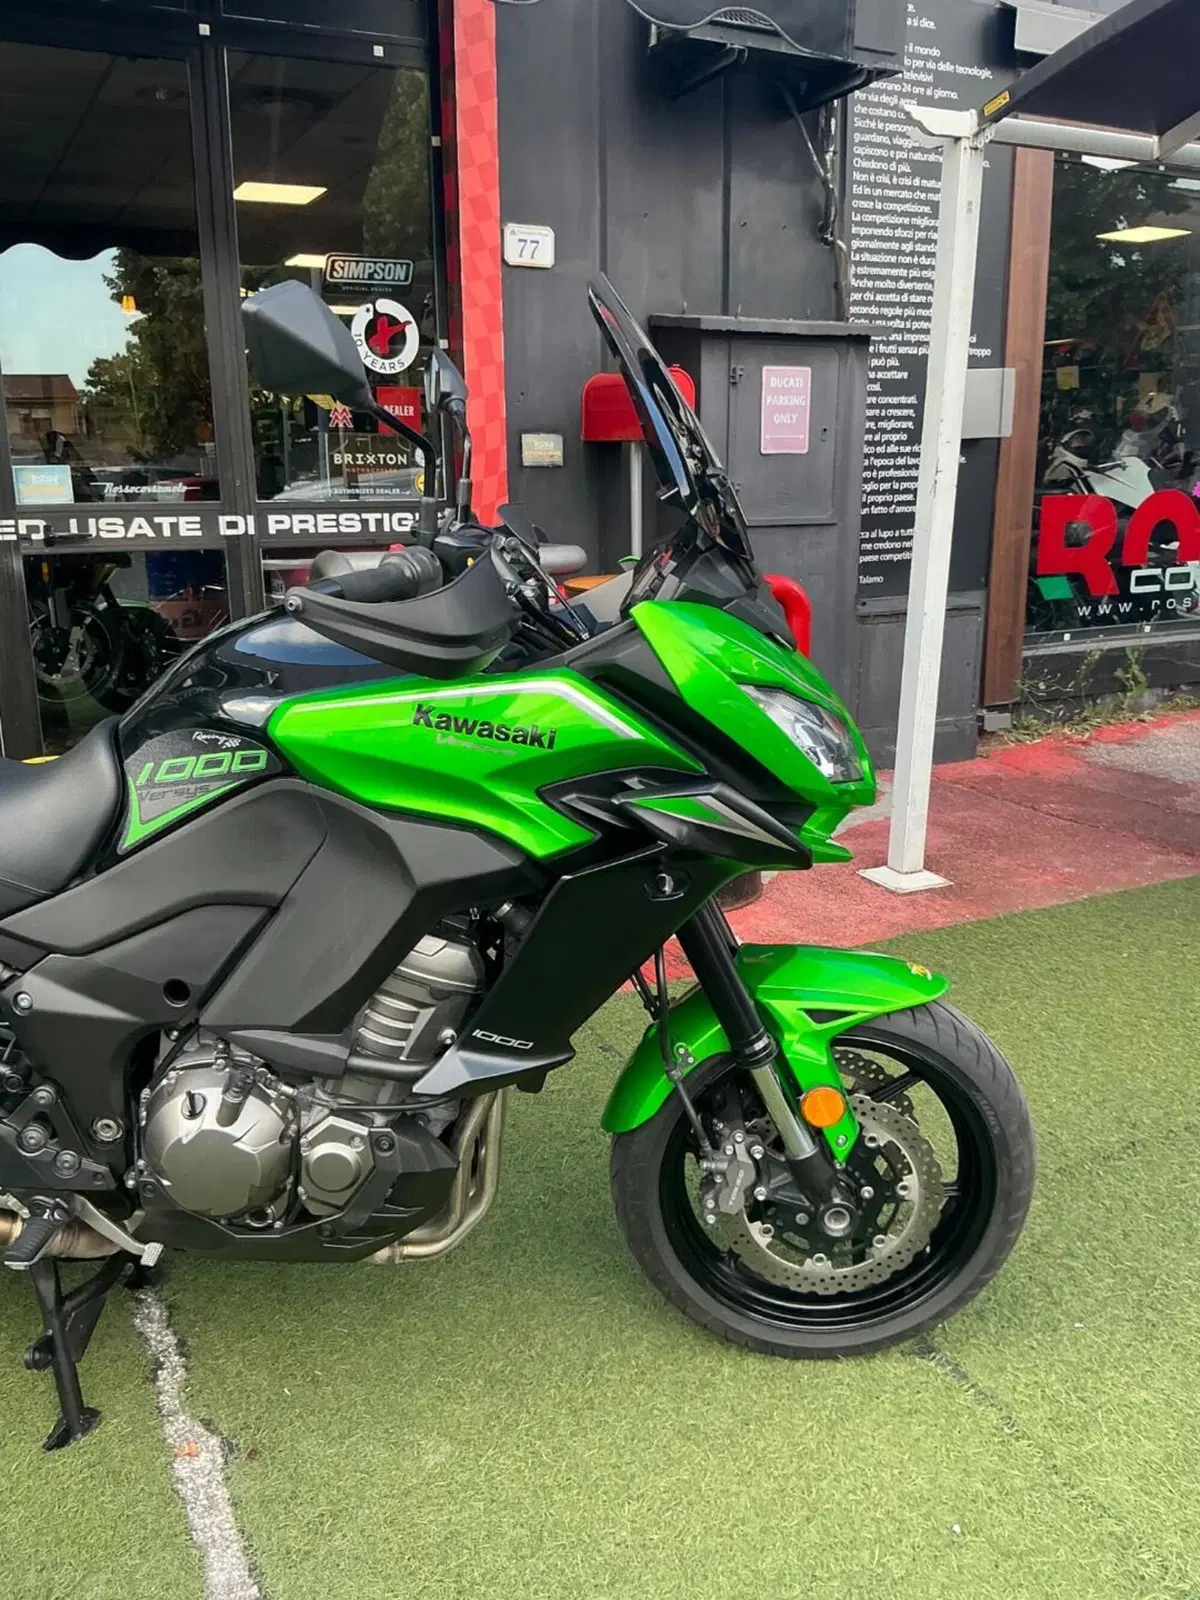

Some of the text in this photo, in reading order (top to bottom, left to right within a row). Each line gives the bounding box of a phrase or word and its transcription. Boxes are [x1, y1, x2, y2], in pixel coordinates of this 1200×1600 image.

[914, 45, 941, 57] mondo
[912, 60, 925, 69] per
[926, 60, 936, 70] via
[937, 61, 955, 72] delle
[902, 83, 911, 93] 24
[912, 87, 925, 95] ore
[926, 86, 933, 96] al
[934, 88, 959, 99] giorno.
[855, 90, 868, 100] Per
[868, 92, 879, 102] via
[880, 93, 898, 106] degli
[854, 104, 868, 114] che
[869, 107, 897, 118] costano
[878, 119, 884, 129] le
[854, 132, 891, 145] guardano,
[853, 145, 889, 157] capiscono
[896, 149, 908, 160] poi
[853, 157, 888, 170] Chiedono
[890, 161, 897, 171] di
[853, 171, 869, 181] Non
[899, 175, 912, 185] crisi
[913, 177, 920, 187] di
[853, 184, 863, 195] Ed
[864, 184, 871, 195] in
[872, 188, 882, 197] un
[883, 188, 913, 199] mercato
[914, 190, 926, 200] che
[852, 199, 932, 213] cresce la competizione.
[852, 211, 861, 221] La
[862, 213, 910, 225] competizione
[852, 224, 894, 237] imponendo
[894, 227, 914, 238] sforzi
[915, 231, 927, 240] per
[518, 238, 540, 259] 77
[851, 239, 900, 251] giornalmente
[901, 241, 914, 253] agli
[851, 251, 860, 261] La
[861, 252, 897, 263] situazione
[898, 255, 912, 265] non
[333, 260, 406, 281] SIMPSON
[857, 266, 908, 278] estremamente
[851, 278, 874, 288] Anche
[875, 279, 896, 289] molto
[850, 292, 862, 302] per
[863, 291, 874, 301] chi
[875, 293, 900, 302] accetta
[901, 292, 908, 302] di
[909, 294, 926, 303] stare
[850, 305, 879, 315] secondo
[880, 306, 903, 317] regole
[879, 344, 897, 354] frutti
[898, 346, 918, 354] senza
[363, 350, 406, 373] YEARS
[870, 356, 885, 368] può
[877, 371, 909, 379] accettare
[770, 377, 804, 389] DUCATI
[766, 395, 807, 406] PARKING
[878, 395, 918, 404] concentrati.
[773, 412, 798, 424] ONLY
[886, 409, 916, 417] crescere,
[877, 420, 914, 430] migliorare,
[874, 432, 881, 441] al
[881, 432, 908, 442] proprio
[876, 444, 885, 453] ed
[886, 444, 899, 453] alle
[333, 453, 408, 466] BRIXTON
[895, 456, 906, 466] del
[879, 482, 892, 491] per
[892, 480, 900, 490] la
[867, 493, 893, 504] proprio
[893, 494, 915, 503] paese.
[871, 505, 888, 514] fatto
[70, 515, 202, 539] USATE
[218, 514, 255, 536] DI
[267, 512, 420, 536] PRESTIG
[870, 529, 877, 538] al
[878, 529, 894, 539] lupo
[873, 541, 901, 550] credono
[859, 555, 879, 564] paese
[412, 703, 558, 751] Kawasaki
[136, 750, 268, 787] 1000
[471, 1029, 534, 1050] 1000
